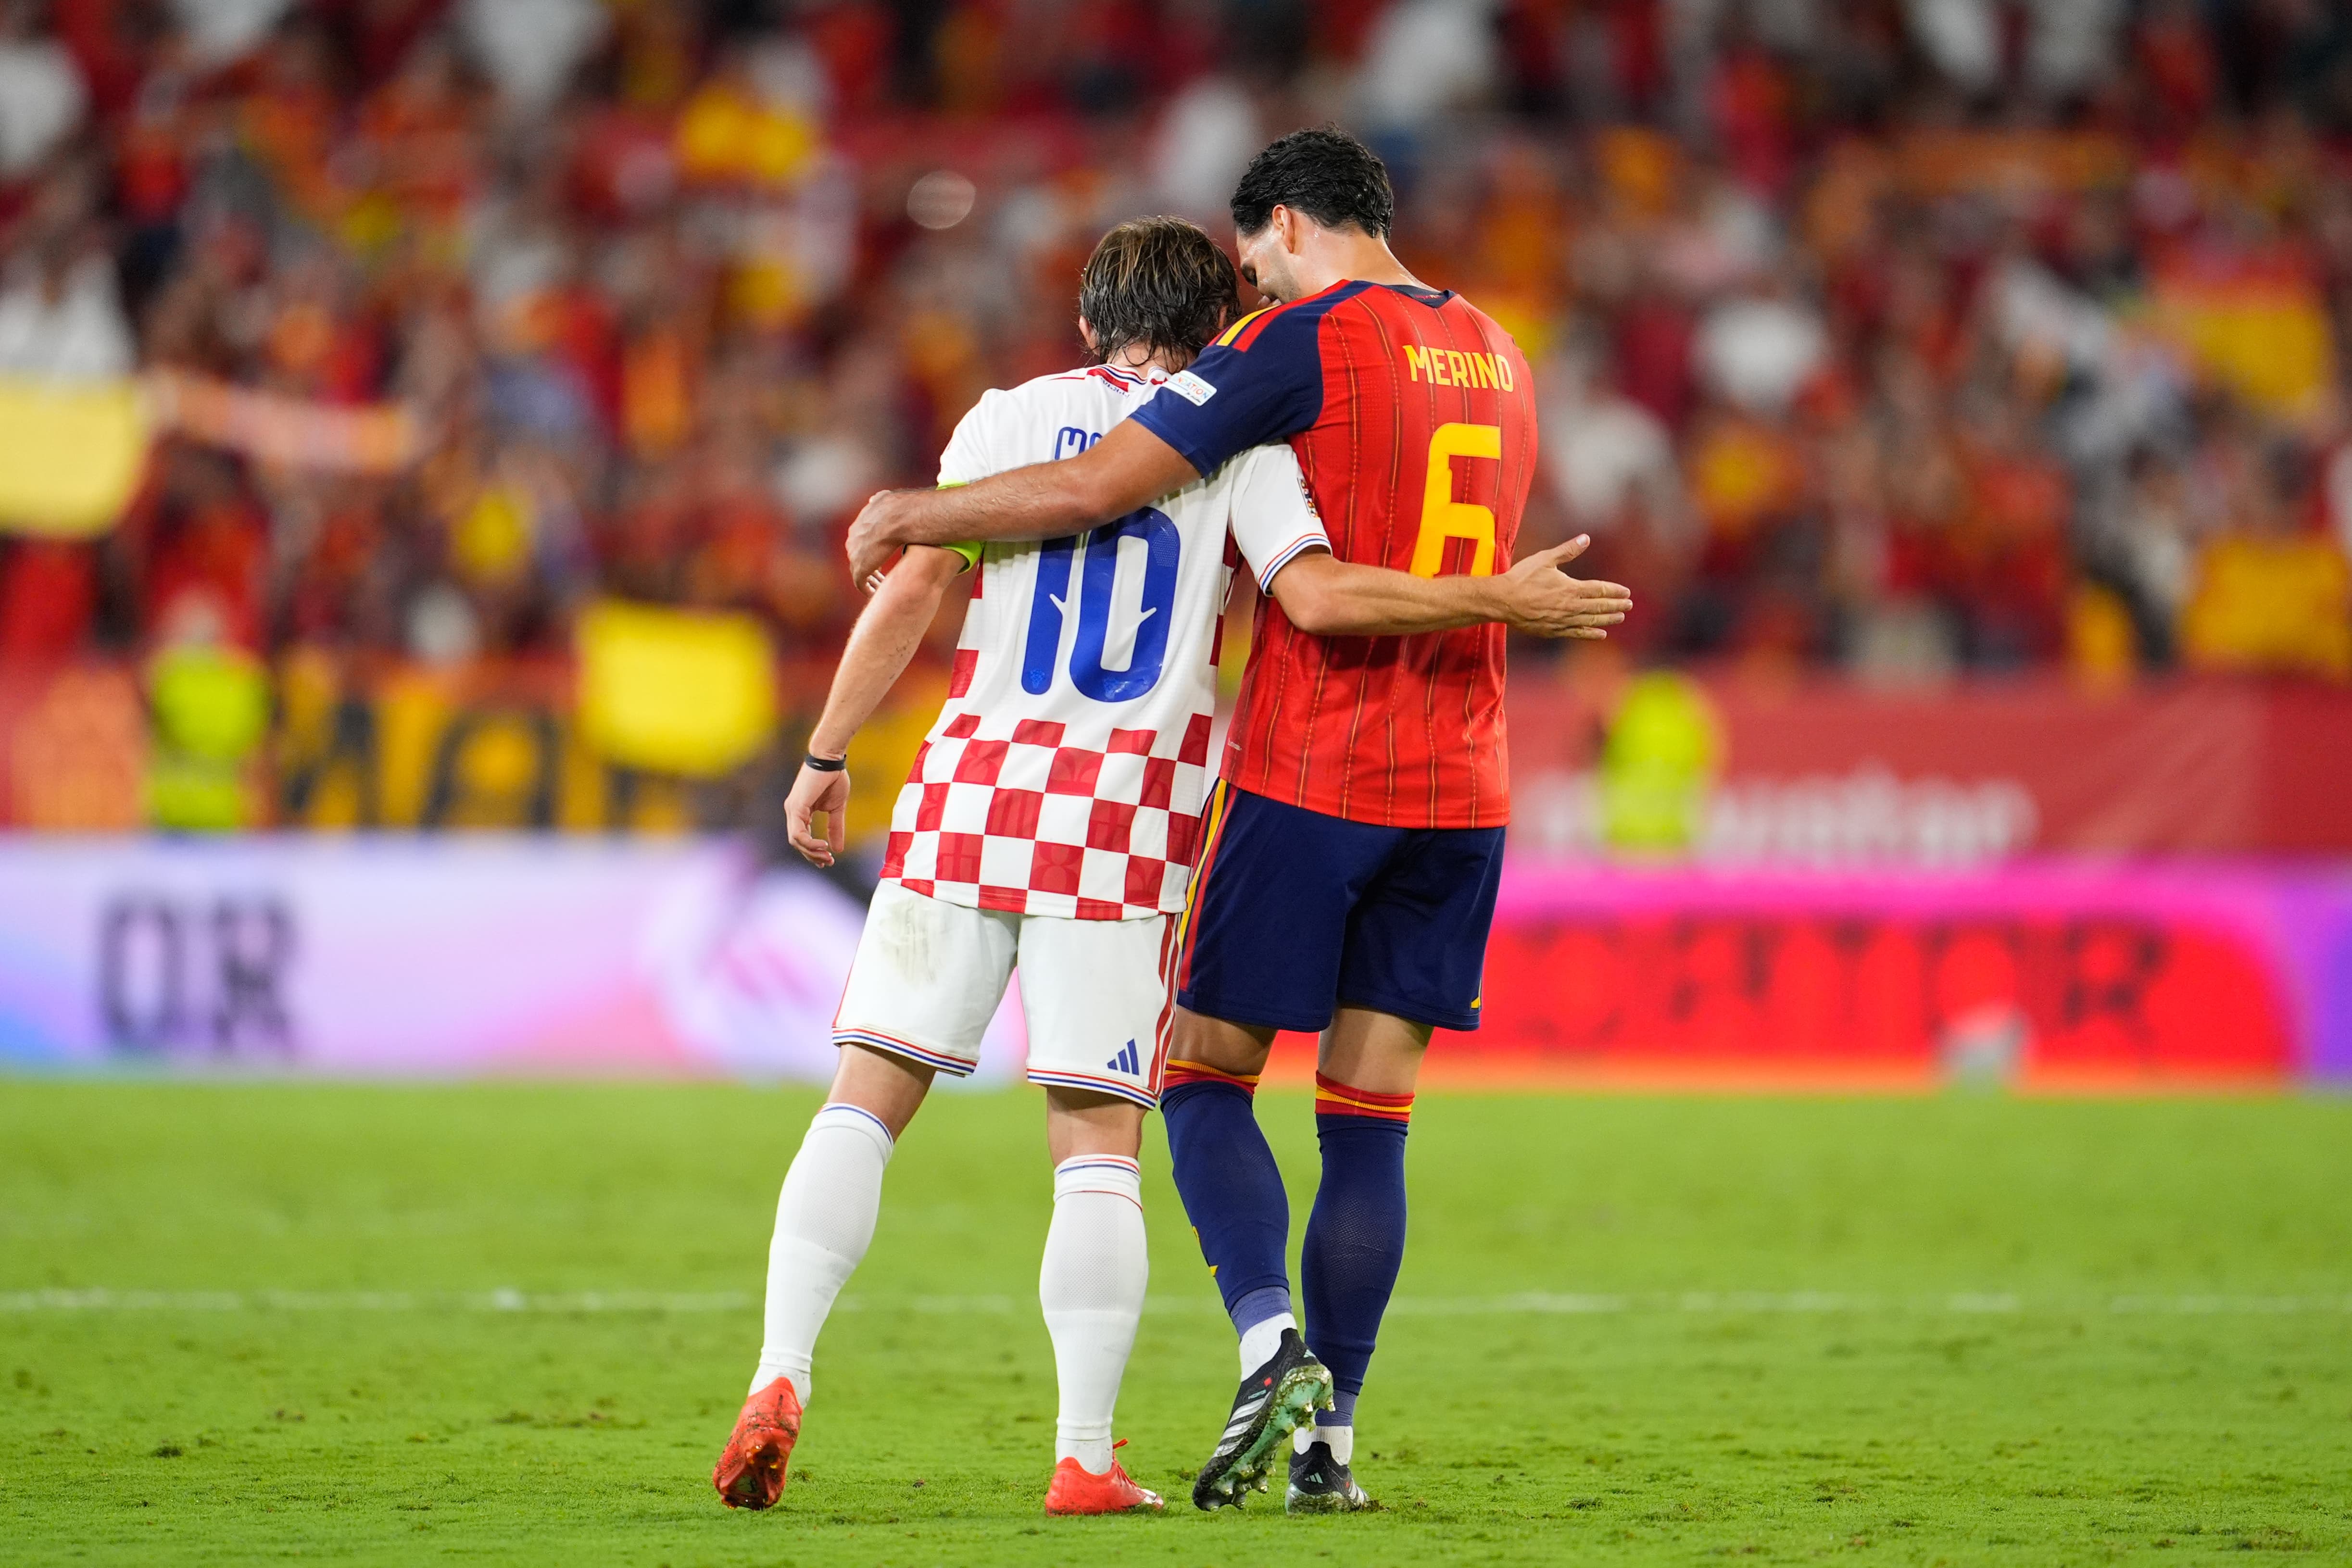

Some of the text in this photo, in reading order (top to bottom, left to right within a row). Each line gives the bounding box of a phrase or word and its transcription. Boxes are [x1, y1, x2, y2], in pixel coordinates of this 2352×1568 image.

[1402, 345, 1514, 393] MERINO
[1409, 422, 1501, 578] 6
[1021, 506, 1181, 703] 10
